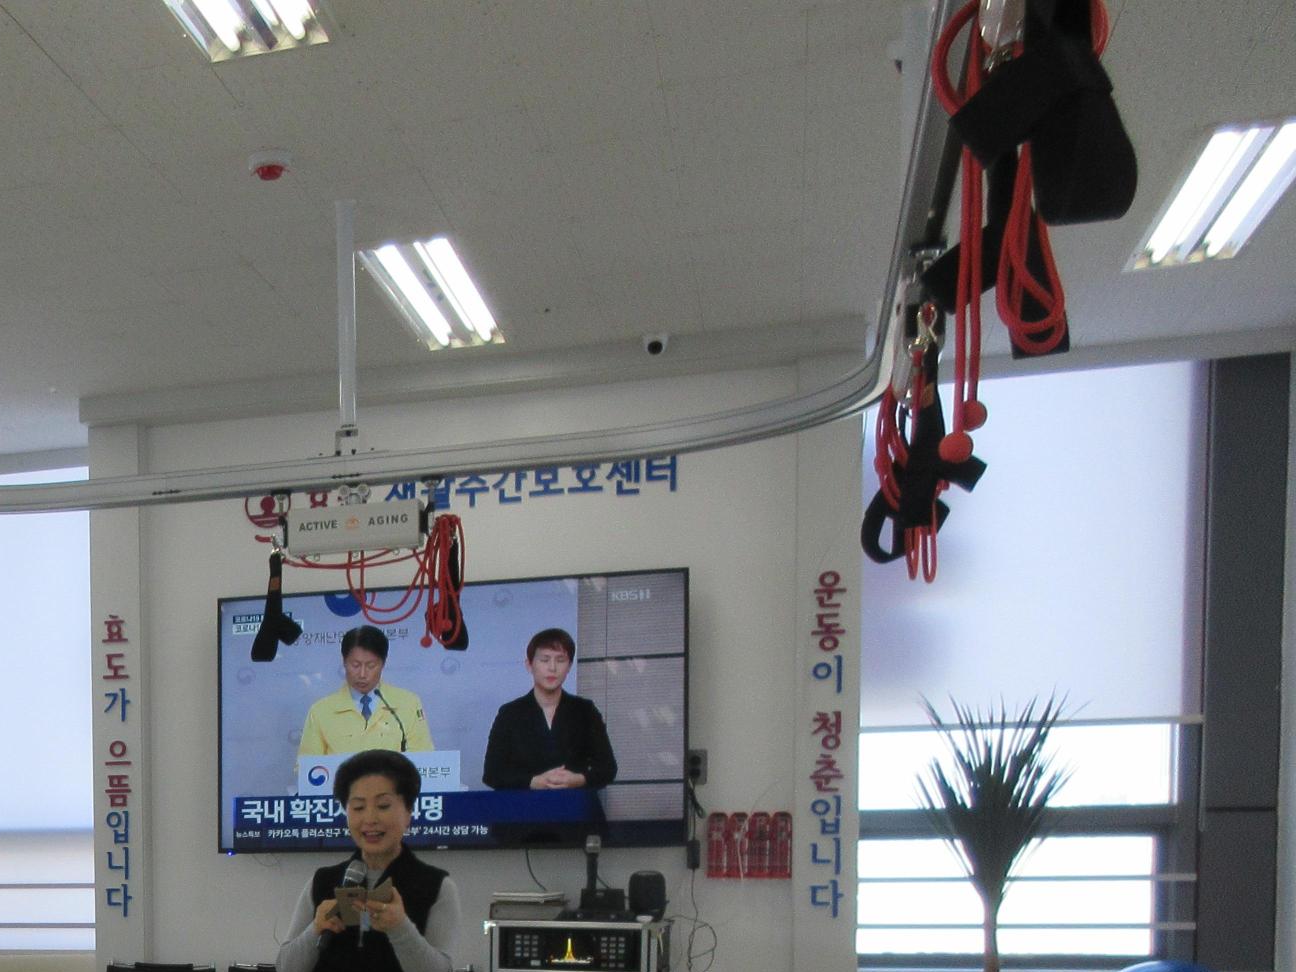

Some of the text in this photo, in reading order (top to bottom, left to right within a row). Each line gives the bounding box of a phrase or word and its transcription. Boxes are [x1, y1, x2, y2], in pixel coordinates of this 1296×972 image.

[298, 513, 410, 533] ACTIVE AGING
[809, 570, 847, 919] 운동이 청춘입니다
[102, 615, 133, 918] 효도가 으뜸입니다
[241, 799, 285, 824] 국내
[267, 828, 299, 839] 카카오톡
[301, 828, 341, 839] 플러스친구
[422, 825, 450, 837] 24시간
[452, 823, 469, 836] 상담
[471, 823, 489, 836] 가능
